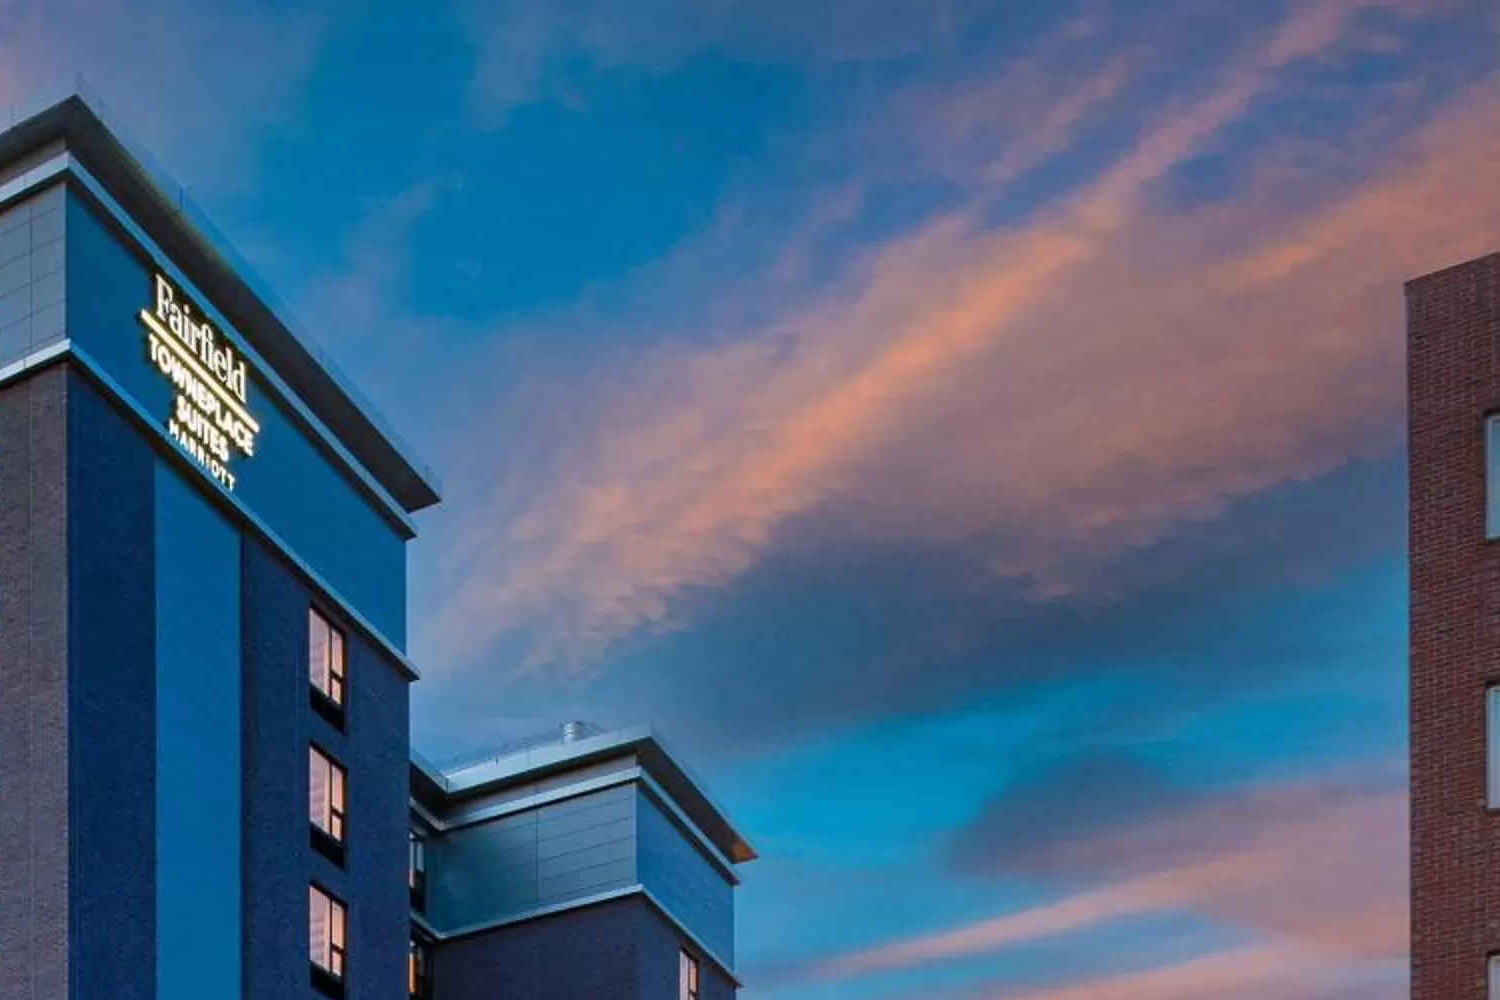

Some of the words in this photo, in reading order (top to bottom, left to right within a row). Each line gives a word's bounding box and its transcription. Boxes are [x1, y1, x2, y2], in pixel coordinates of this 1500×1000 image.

[155, 273, 247, 404] Fairfield
[149, 333, 254, 457] TOWNEPLACE
[176, 394, 229, 462] SUITES
[169, 418, 236, 492] MARRIOTT
